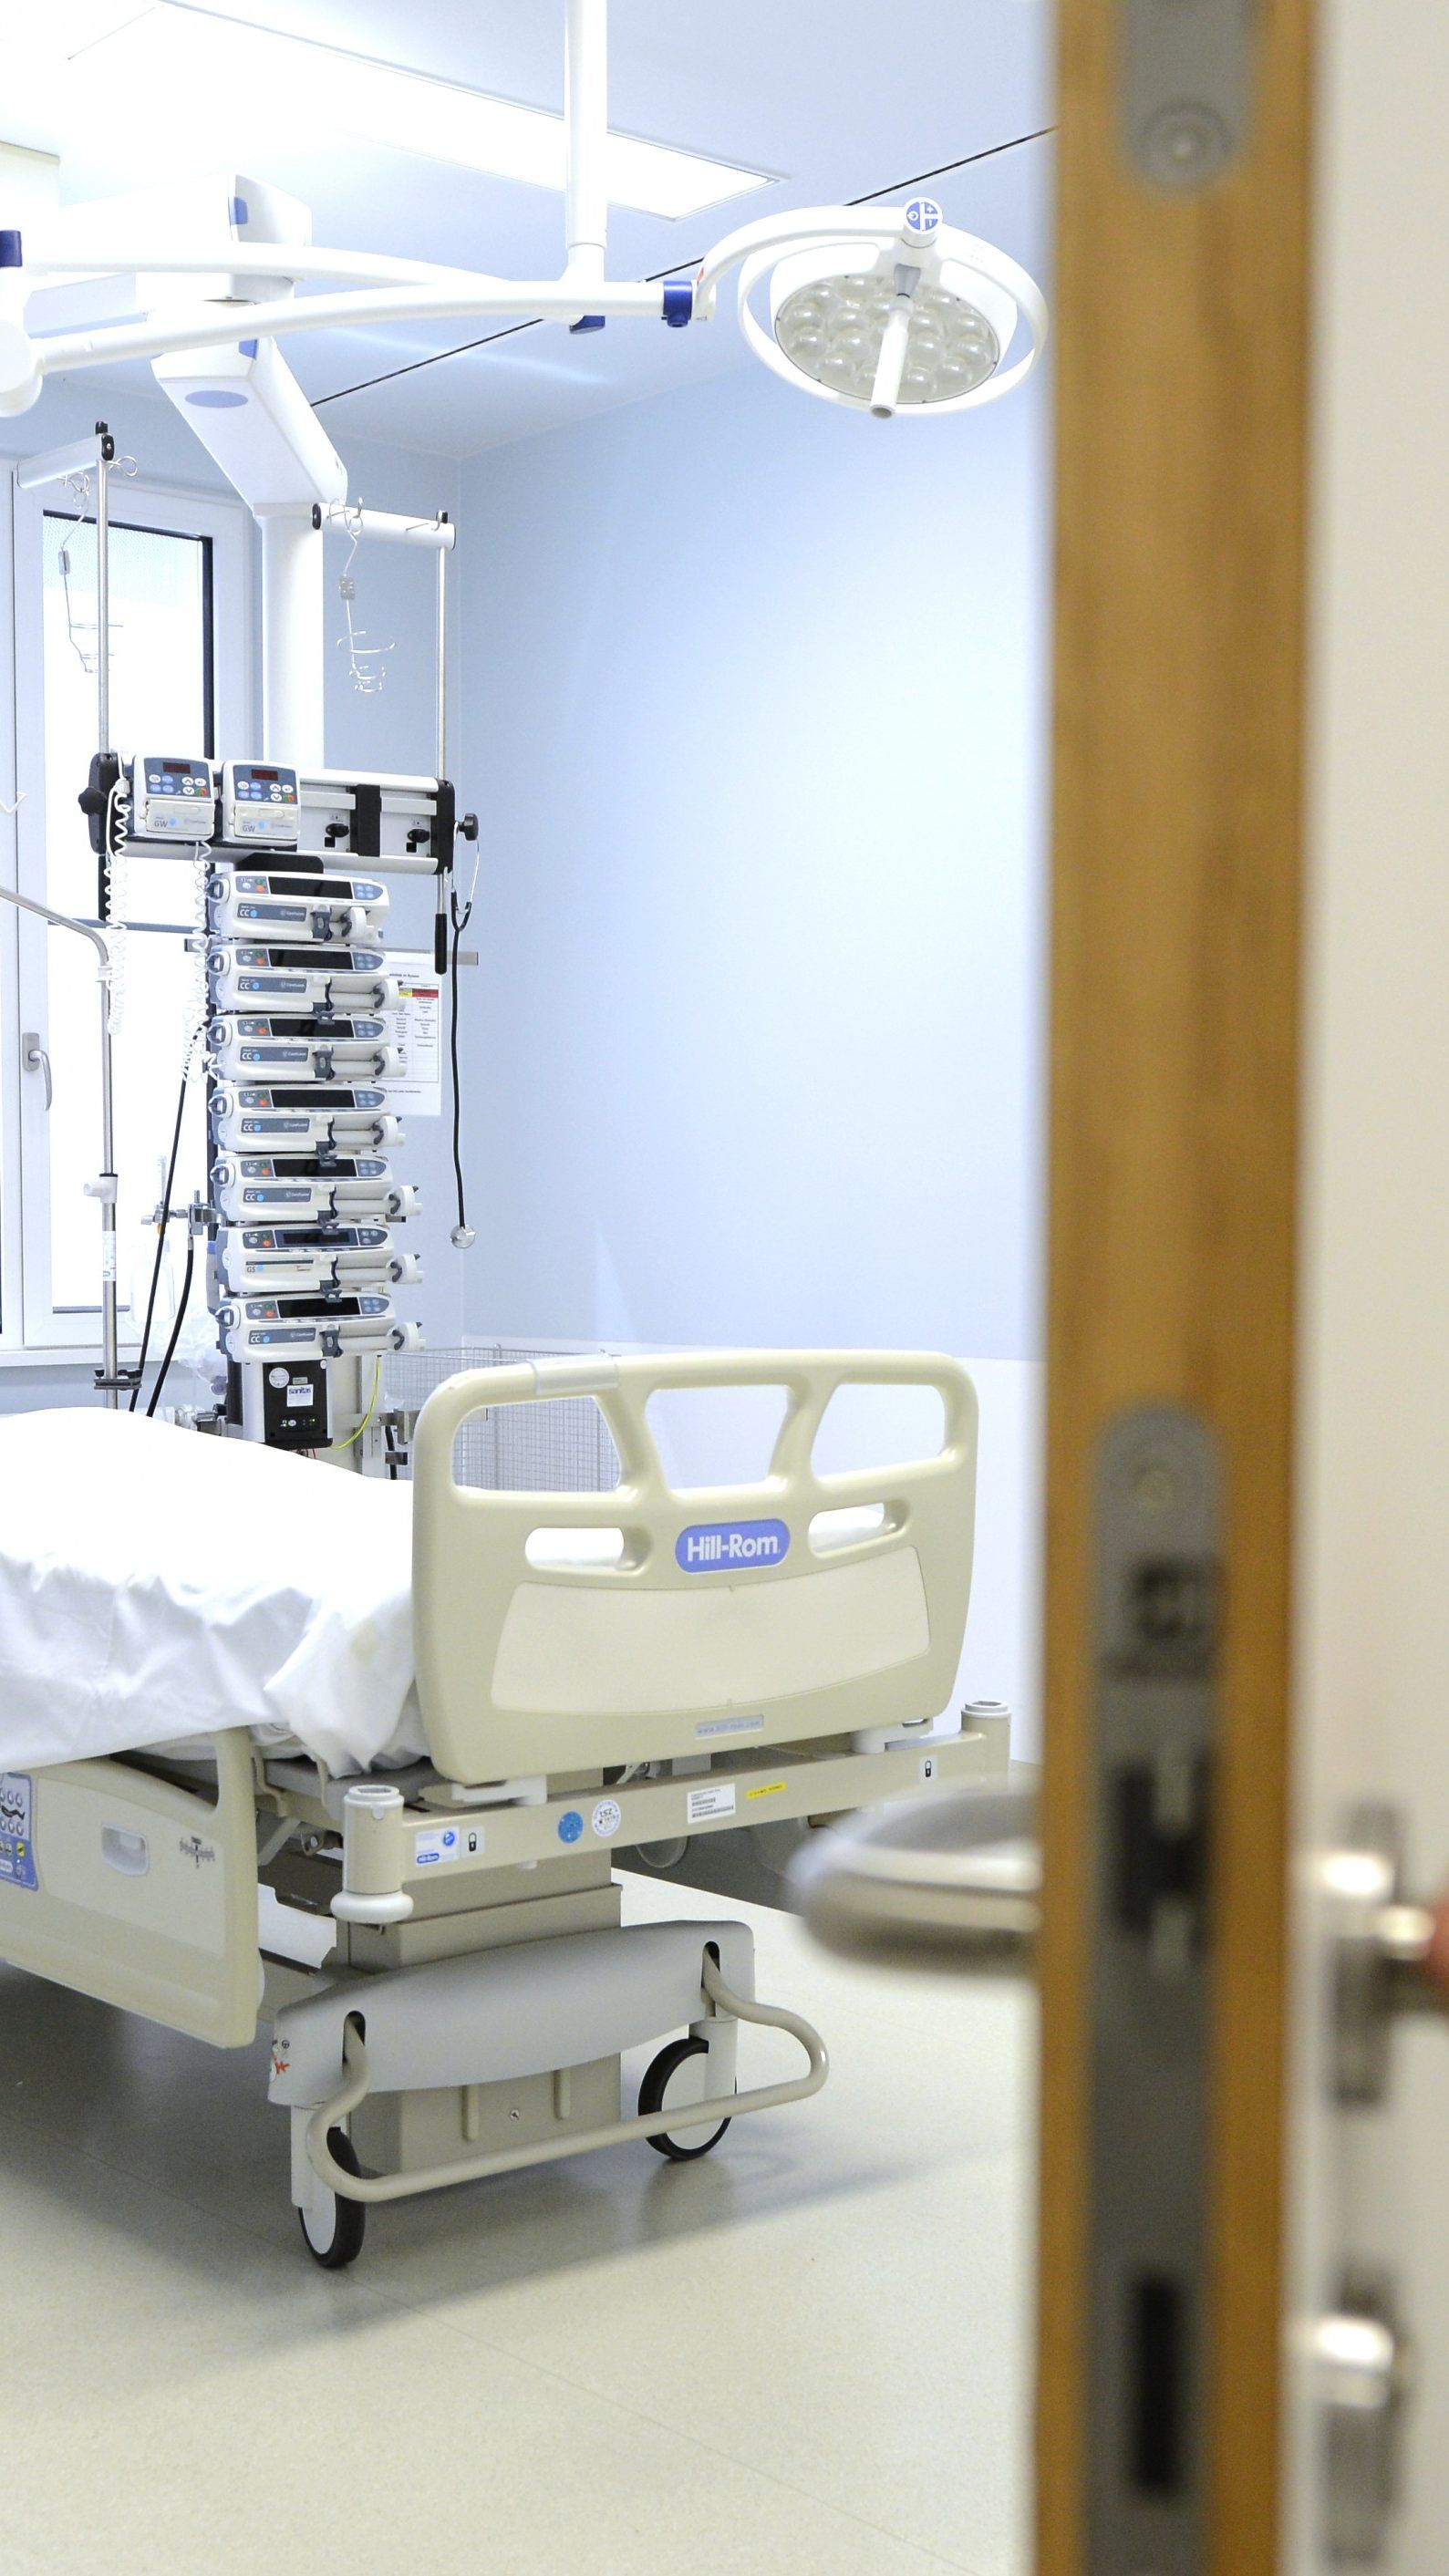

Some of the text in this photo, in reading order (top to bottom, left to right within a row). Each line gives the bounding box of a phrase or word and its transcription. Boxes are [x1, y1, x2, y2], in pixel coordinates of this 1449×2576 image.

[154, 820, 168, 828] GW
[240, 982, 250, 990] CC
[688, 1534, 778, 1562] Hill-Rom
